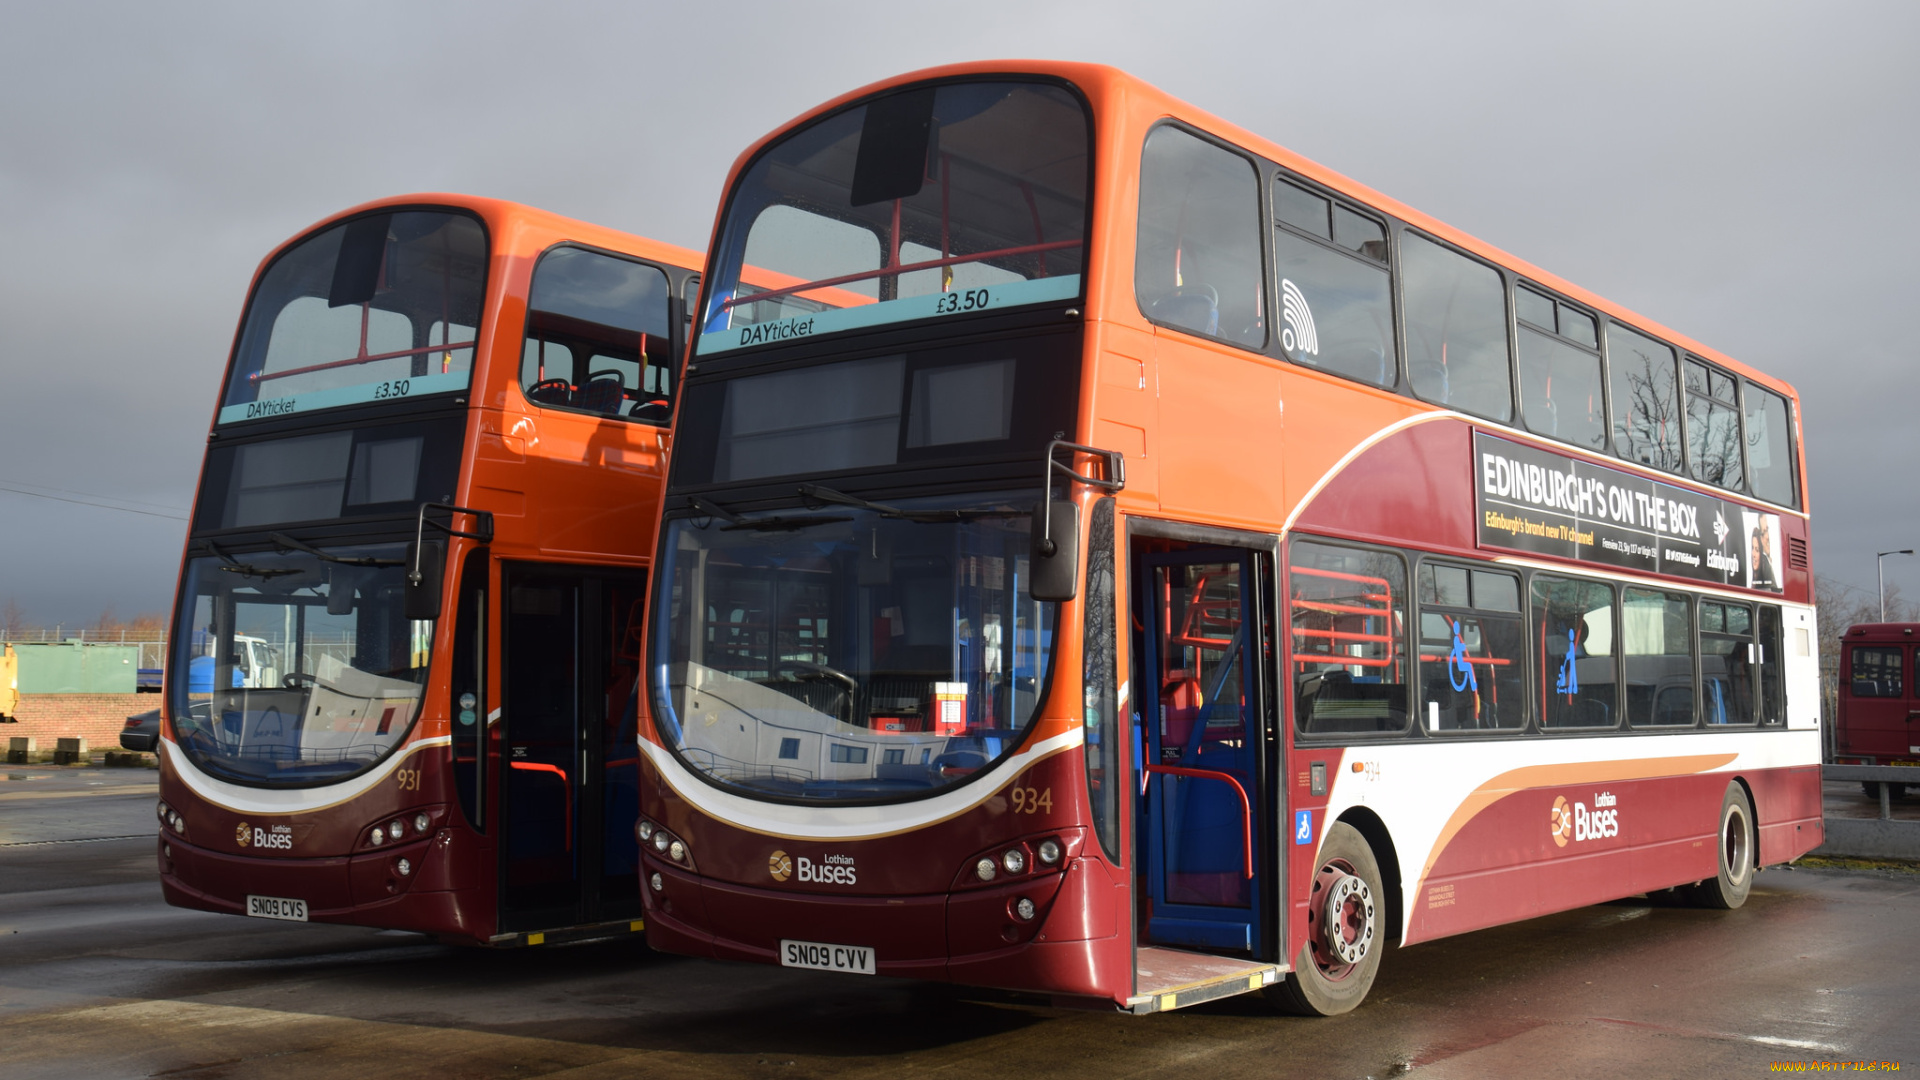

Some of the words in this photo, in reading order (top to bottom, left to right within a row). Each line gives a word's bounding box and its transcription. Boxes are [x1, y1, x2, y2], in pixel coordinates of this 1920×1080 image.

[740, 318, 815, 346] DAYticket
[936, 289, 989, 313] £3.50
[247, 398, 296, 418] DAYticket
[375, 380, 410, 399] £3.50
[1483, 453, 1607, 518] EDINBURGH'S
[1609, 486, 1635, 525] ON
[1635, 492, 1667, 532] THE
[1668, 500, 1700, 538] BOX
[1485, 511, 1524, 536] Edinburgh's
[1525, 518, 1545, 537] brand
[1546, 525, 1560, 539] new
[1560, 525, 1568, 541] TV
[1568, 527, 1594, 546] channel
[1706, 549, 1739, 577] Edinburgh
[397, 769, 421, 791] 931
[1365, 761, 1380, 781] 934
[1012, 787, 1053, 814] 934
[1595, 791, 1617, 807] Lothian
[272, 824, 292, 834] Lothian
[1575, 802, 1618, 841] Buses
[254, 828, 292, 850] Buses
[797, 857, 857, 885] Buses
[824, 853, 854, 865] Lothian
[252, 898, 280, 915] SN09
[281, 901, 303, 917] CVS
[788, 943, 830, 967] SN09
[835, 946, 867, 970] CVV
